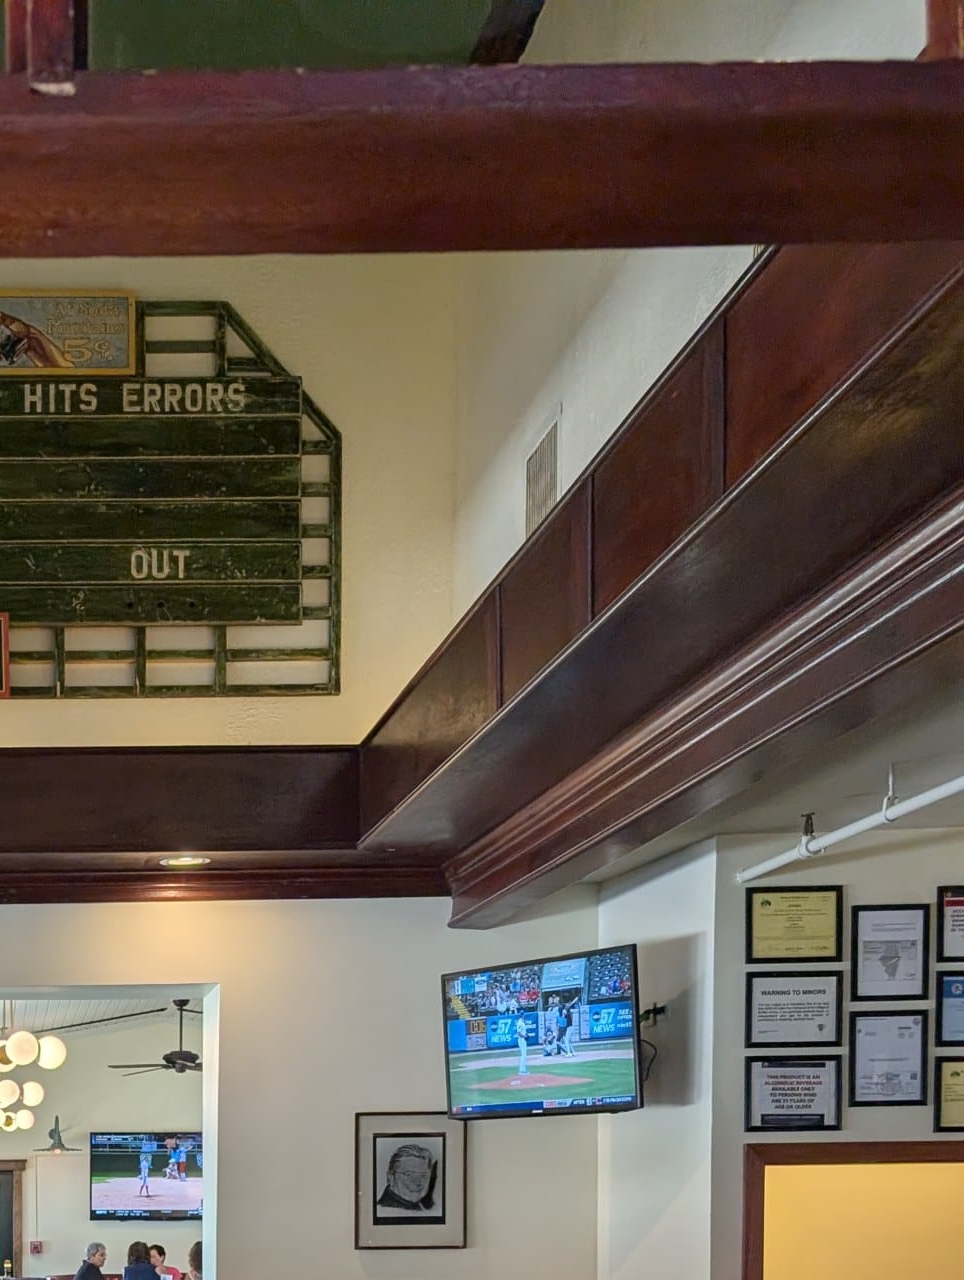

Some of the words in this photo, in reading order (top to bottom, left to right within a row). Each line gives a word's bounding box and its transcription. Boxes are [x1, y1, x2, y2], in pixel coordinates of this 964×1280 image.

[23, 384, 98, 413] HITS
[122, 383, 246, 412] ERRORS
[129, 550, 190, 580] OUT
[497, 1019, 511, 1034] 57
[600, 1008, 615, 1024] 57
